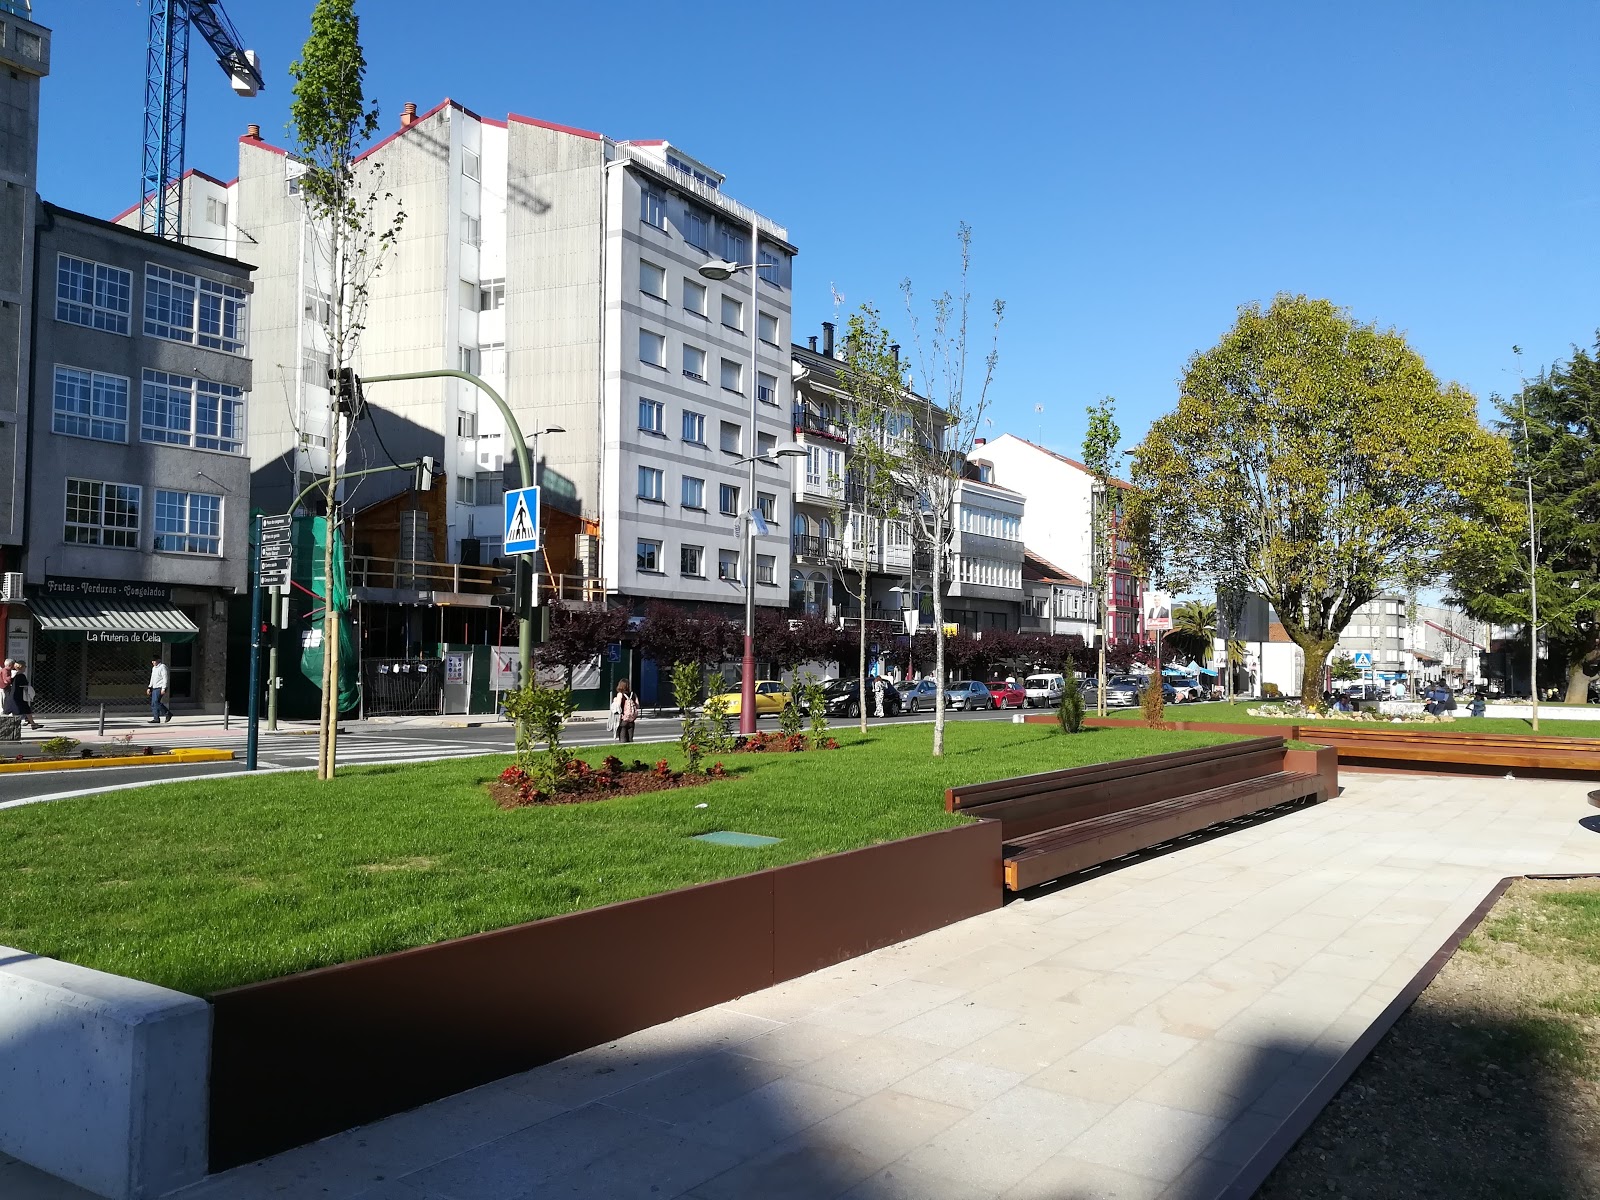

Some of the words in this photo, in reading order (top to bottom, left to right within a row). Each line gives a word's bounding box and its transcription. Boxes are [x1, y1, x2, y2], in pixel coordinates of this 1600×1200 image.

[47, 580, 75, 593] Frutas
[81, 582, 117, 594] Verduras
[123, 585, 166, 598] Congelados
[86, 631, 98, 642] La
[130, 632, 141, 643] de
[142, 631, 162, 643] Celia
